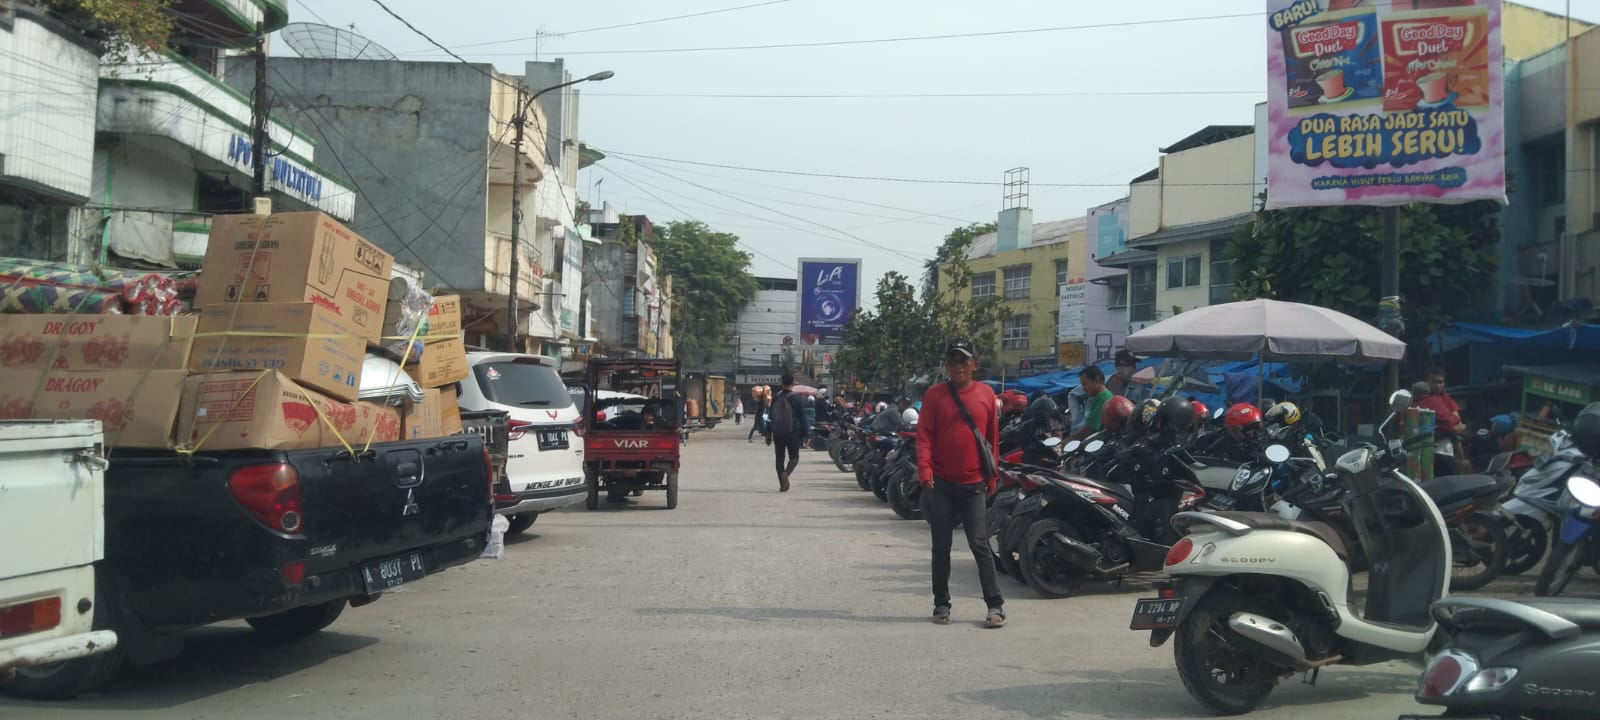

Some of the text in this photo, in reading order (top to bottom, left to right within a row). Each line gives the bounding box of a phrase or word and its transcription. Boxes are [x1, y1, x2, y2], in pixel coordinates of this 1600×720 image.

[1301, 109, 1469, 135] DUA RASA JADI SATU
[1305, 128, 1465, 161] LEBIH SERU!
[1314, 178, 1348, 188] KARENA
[1351, 176, 1375, 185] HIDUP
[1404, 174, 1436, 184] BANYAK
[43, 321, 96, 335] DRGON
[45, 378, 104, 392] DRAGON
[614, 440, 649, 448] VIAR
[365, 553, 423, 584] A 8037 PI
[1138, 603, 1143, 613] A
